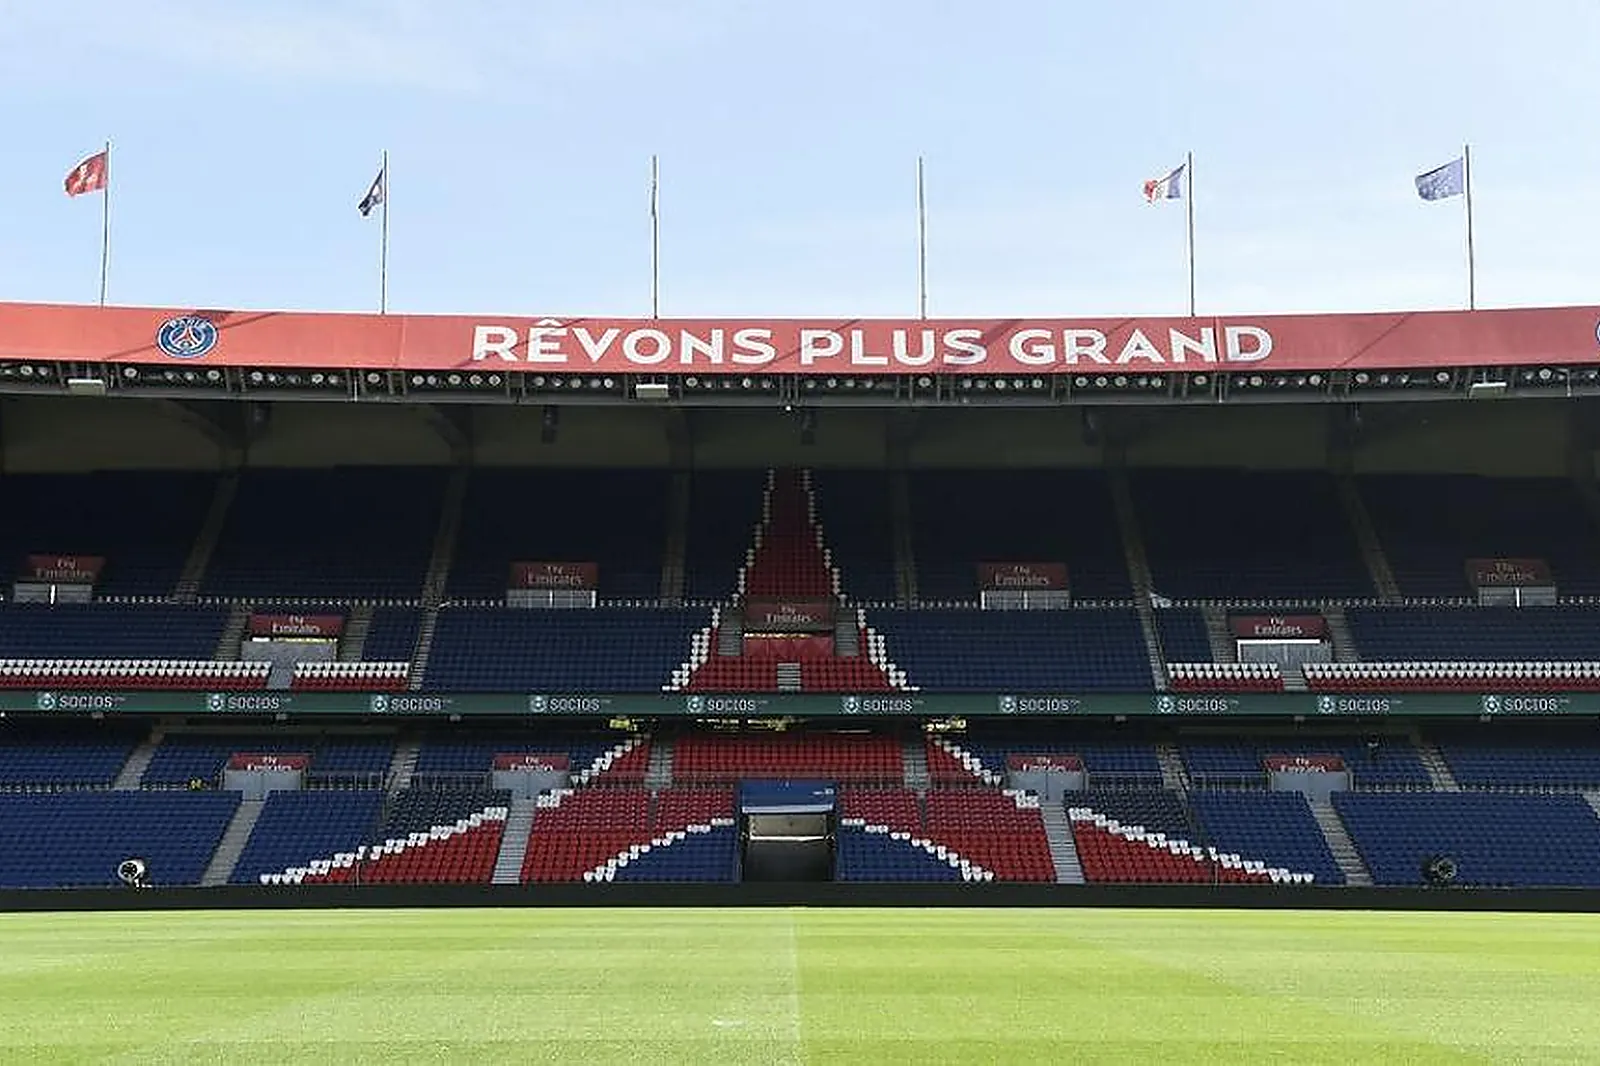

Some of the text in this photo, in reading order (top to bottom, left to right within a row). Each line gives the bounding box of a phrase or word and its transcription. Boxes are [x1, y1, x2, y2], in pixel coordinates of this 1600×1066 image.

[472, 318, 1273, 365] RÊVONS PLUS GRAND
